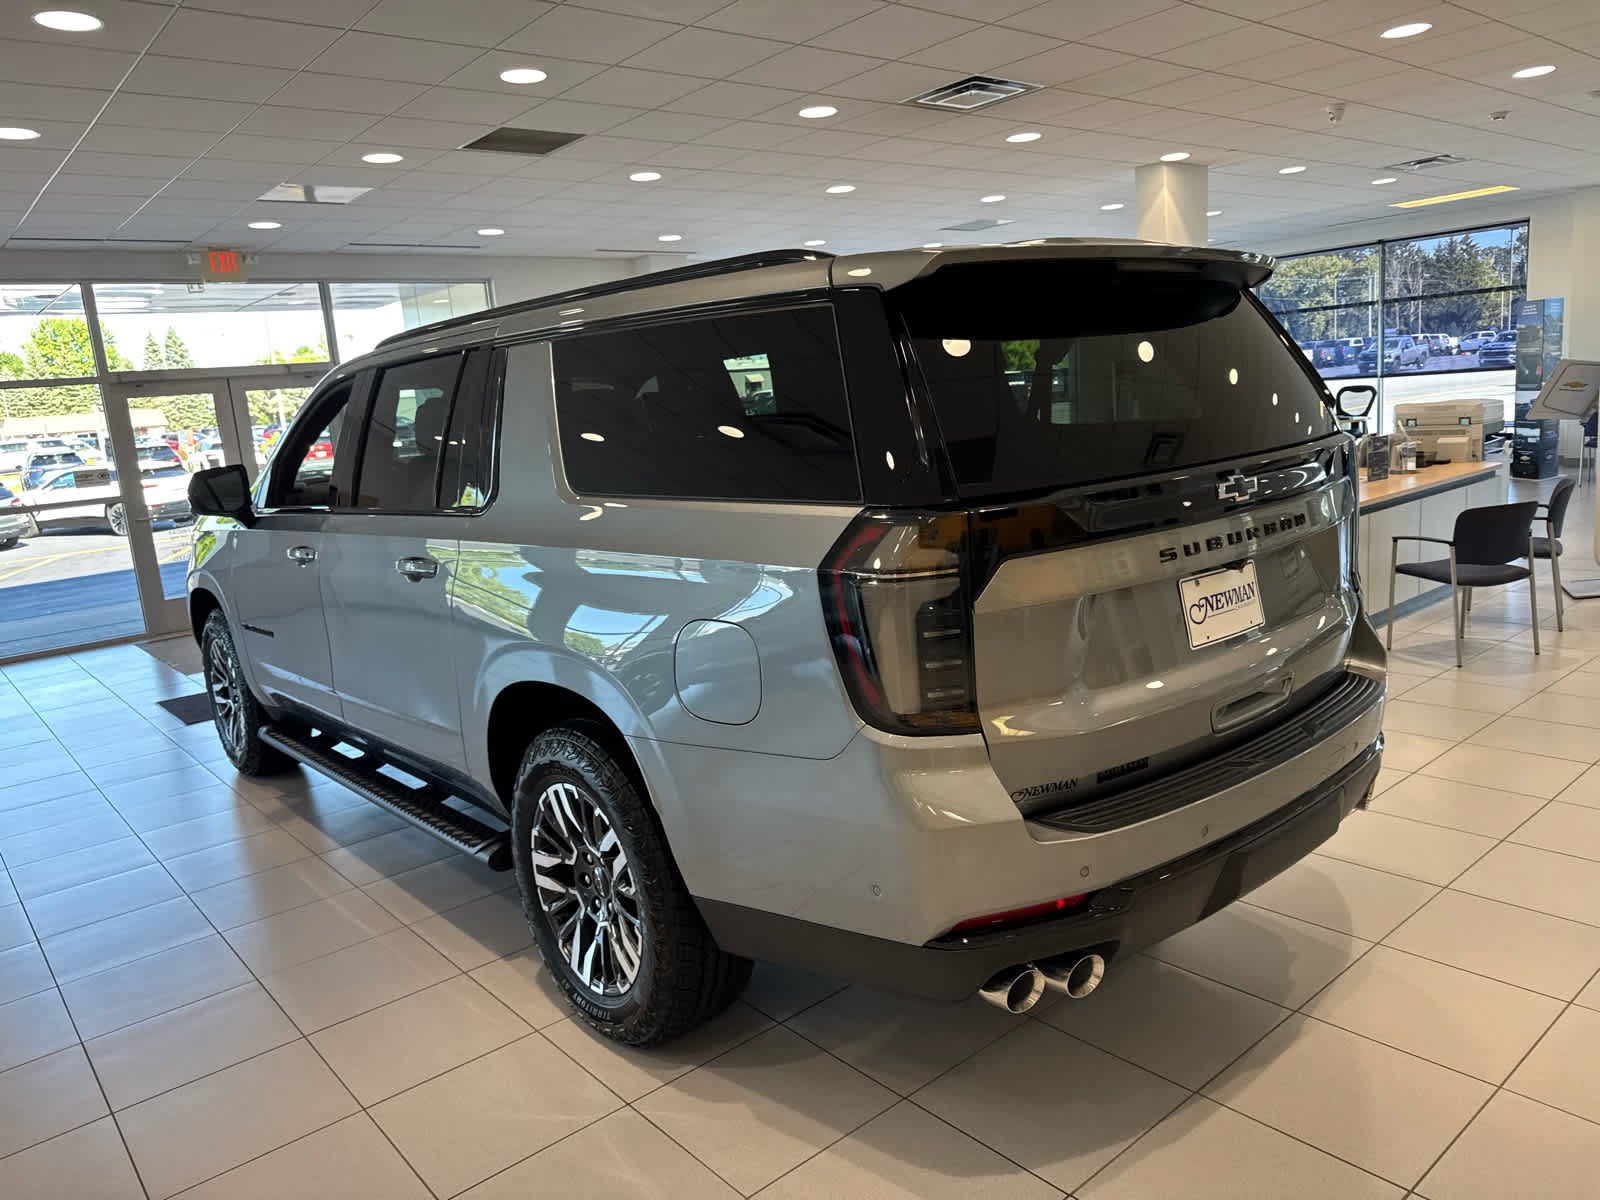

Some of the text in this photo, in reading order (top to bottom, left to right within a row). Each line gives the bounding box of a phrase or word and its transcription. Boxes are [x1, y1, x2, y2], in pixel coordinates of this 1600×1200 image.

[208, 252, 238, 272] EXIT
[1159, 513, 1306, 563] SUBURBAN
[1189, 581, 1256, 625] NEWMAN
[1011, 778, 1079, 803] NEWMAN
